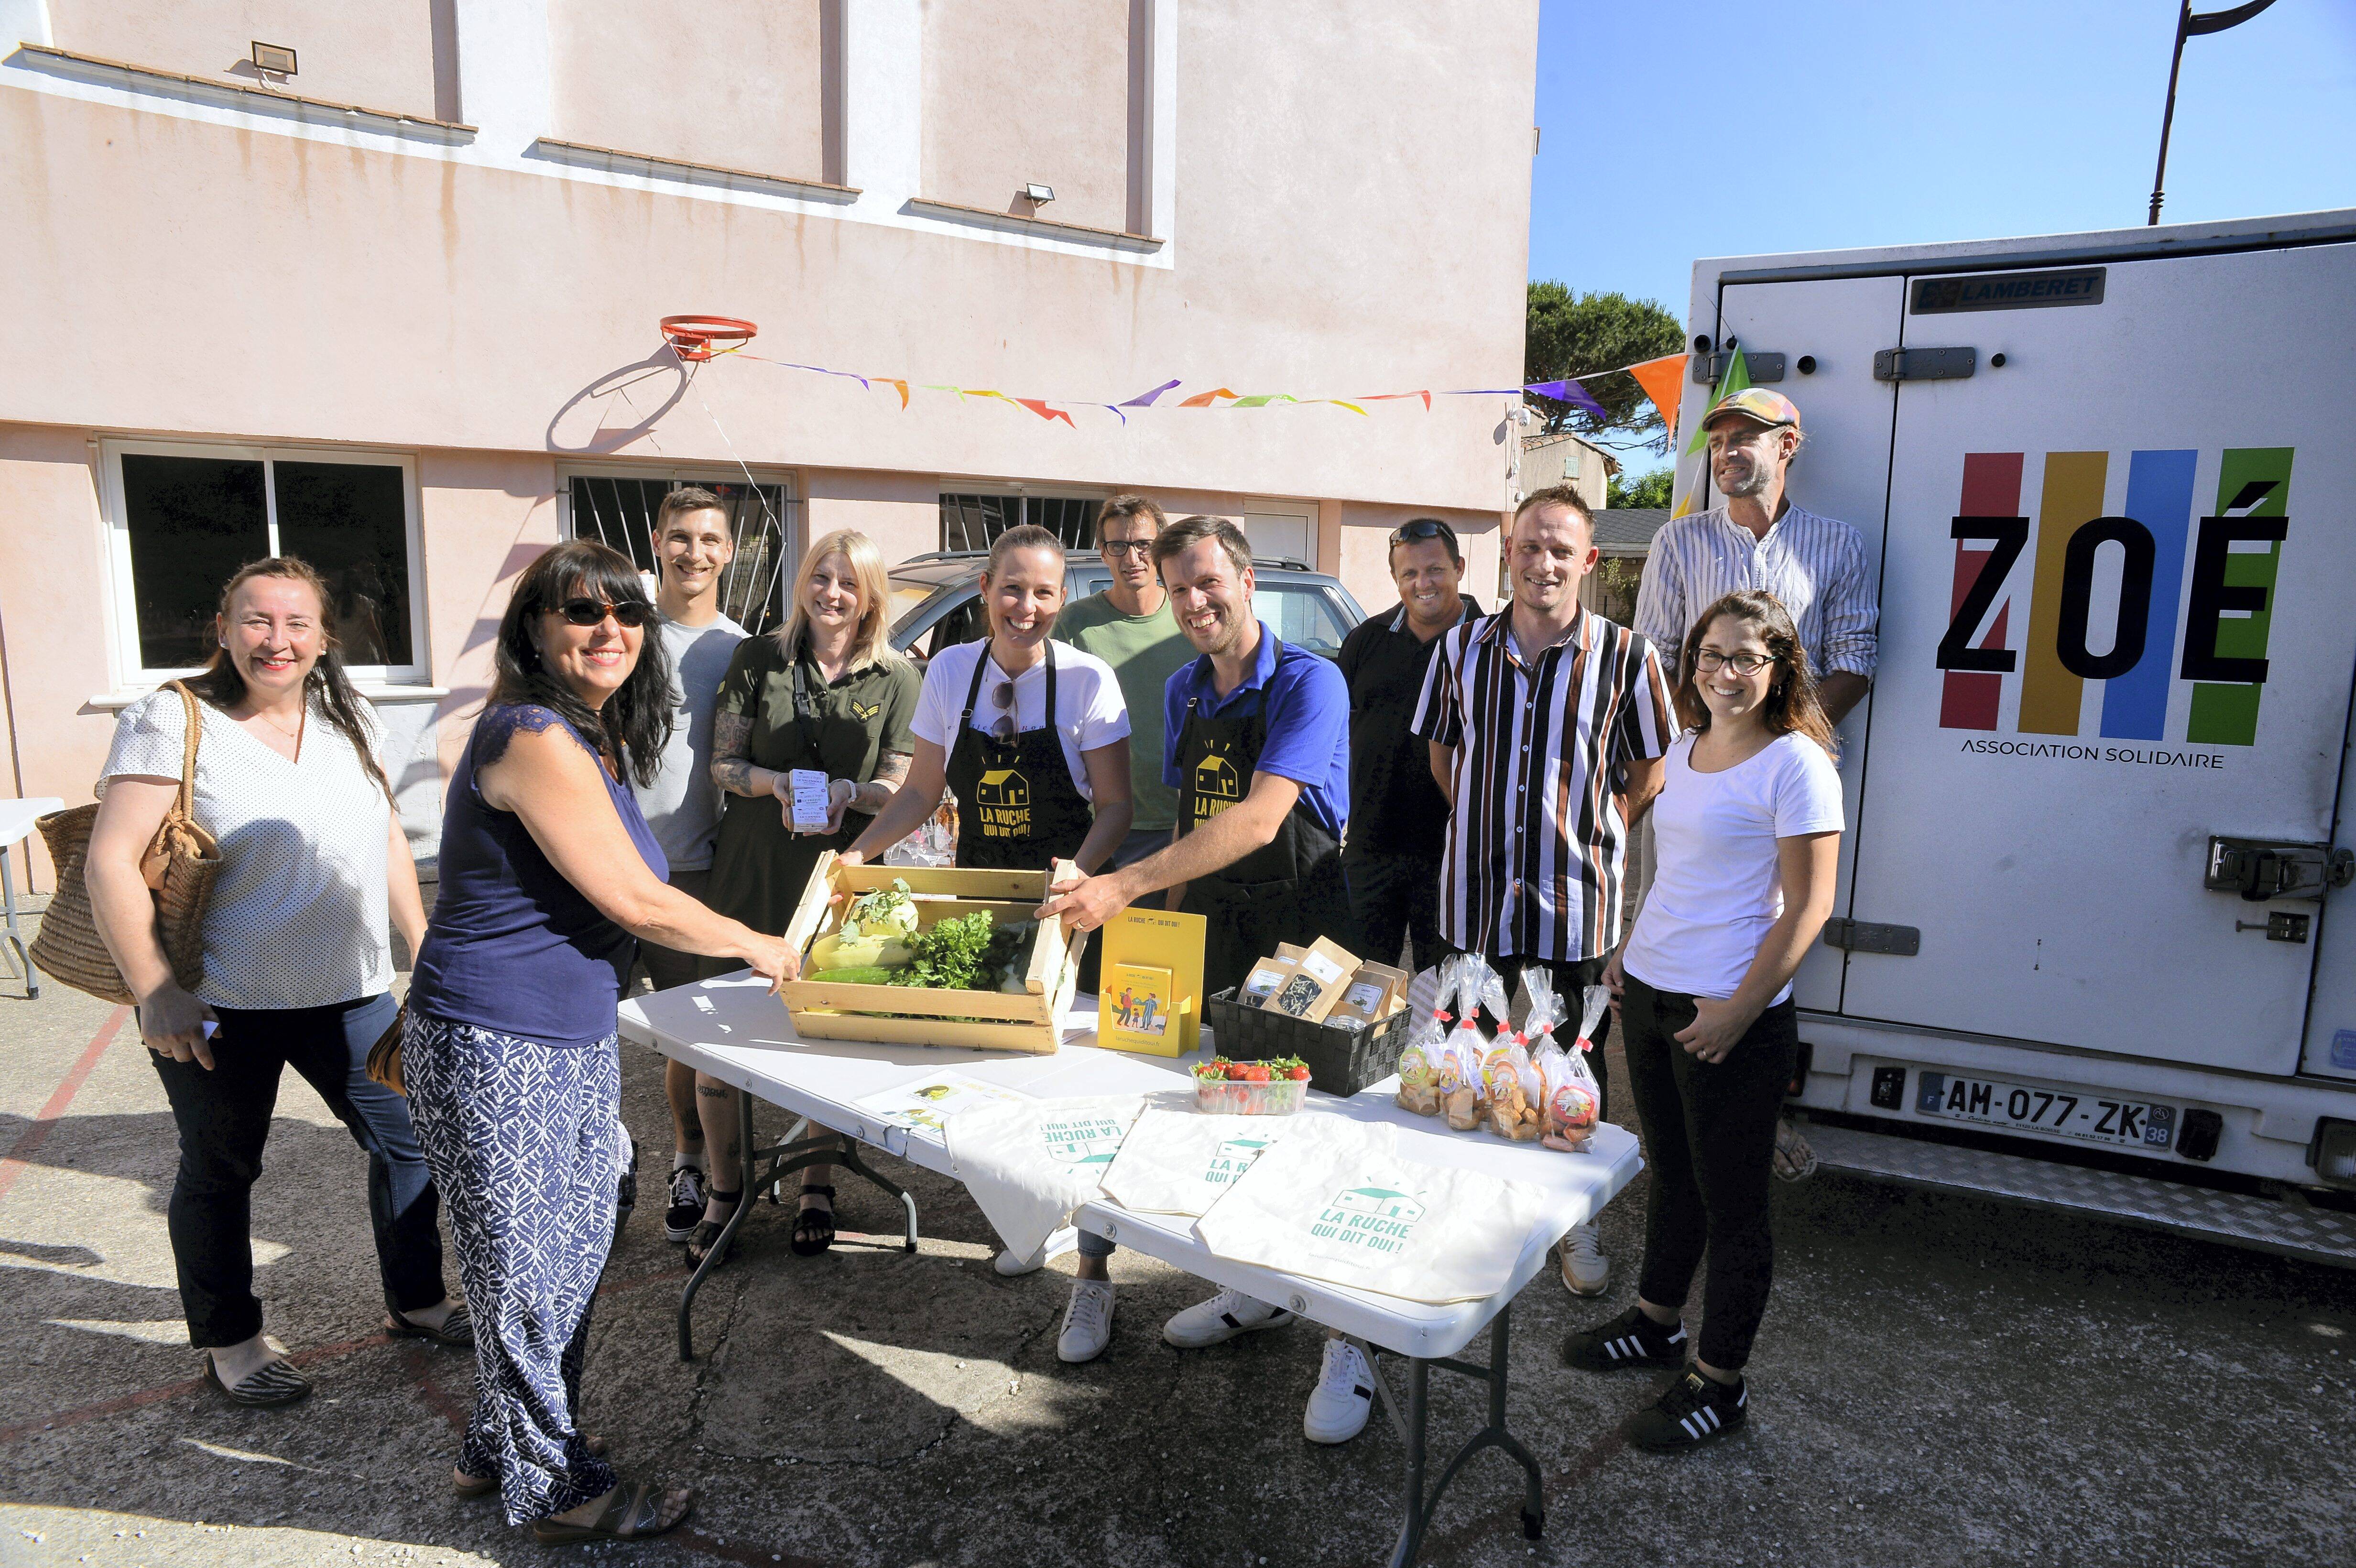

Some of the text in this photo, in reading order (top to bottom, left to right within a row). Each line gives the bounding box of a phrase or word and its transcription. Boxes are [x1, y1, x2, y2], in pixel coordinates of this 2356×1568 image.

[1962, 276, 2099, 301] LAMBERET
[1936, 480, 2290, 683] ZOÉ
[1961, 740, 2225, 769] ASSOCIATION SOLIDAIRE
[1195, 796, 1207, 816] LA
[979, 806, 1031, 826] LA RUCHE
[983, 824, 998, 837] QUI
[1115, 1035, 1160, 1046] laruchequiditoui.fr
[1927, 1096, 1935, 1104] F
[1947, 1080, 2144, 1138] AM-077-ZK
[1072, 1120, 1091, 1128] DIT
[1042, 1126, 1122, 1142] LA RUCHE
[2147, 1127, 2168, 1143] 38
[1210, 1159, 1230, 1171] LA
[1205, 1171, 1229, 1182] QUI
[1320, 1209, 1413, 1239] LA RUCHE
[1311, 1223, 1338, 1238] QUI
[1339, 1230, 1367, 1244] DIT
